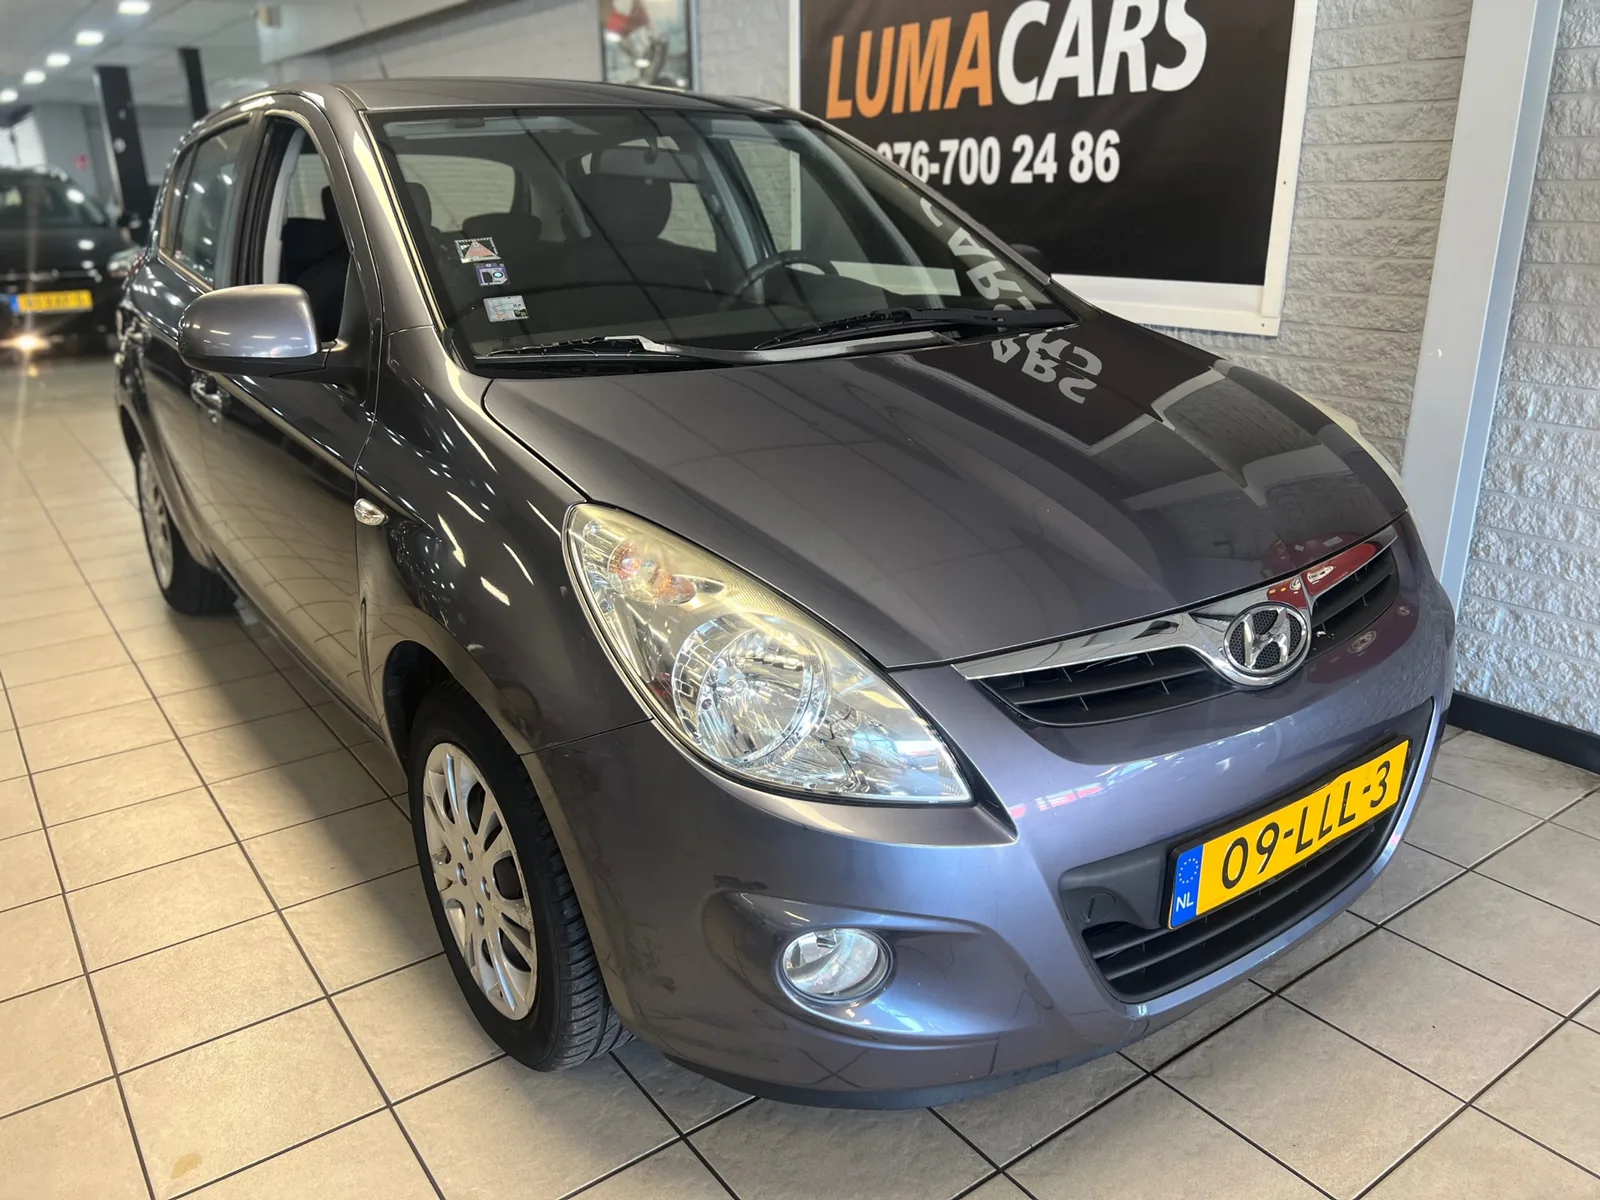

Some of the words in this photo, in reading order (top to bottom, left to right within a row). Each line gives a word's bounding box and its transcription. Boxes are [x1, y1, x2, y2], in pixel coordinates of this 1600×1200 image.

[825, 0, 1208, 119] LUMACARS
[1010, 132, 1058, 184] 24
[1068, 129, 1121, 184] 86
[1221, 760, 1391, 890] 09-LLL-3
[1175, 891, 1195, 912] NL
